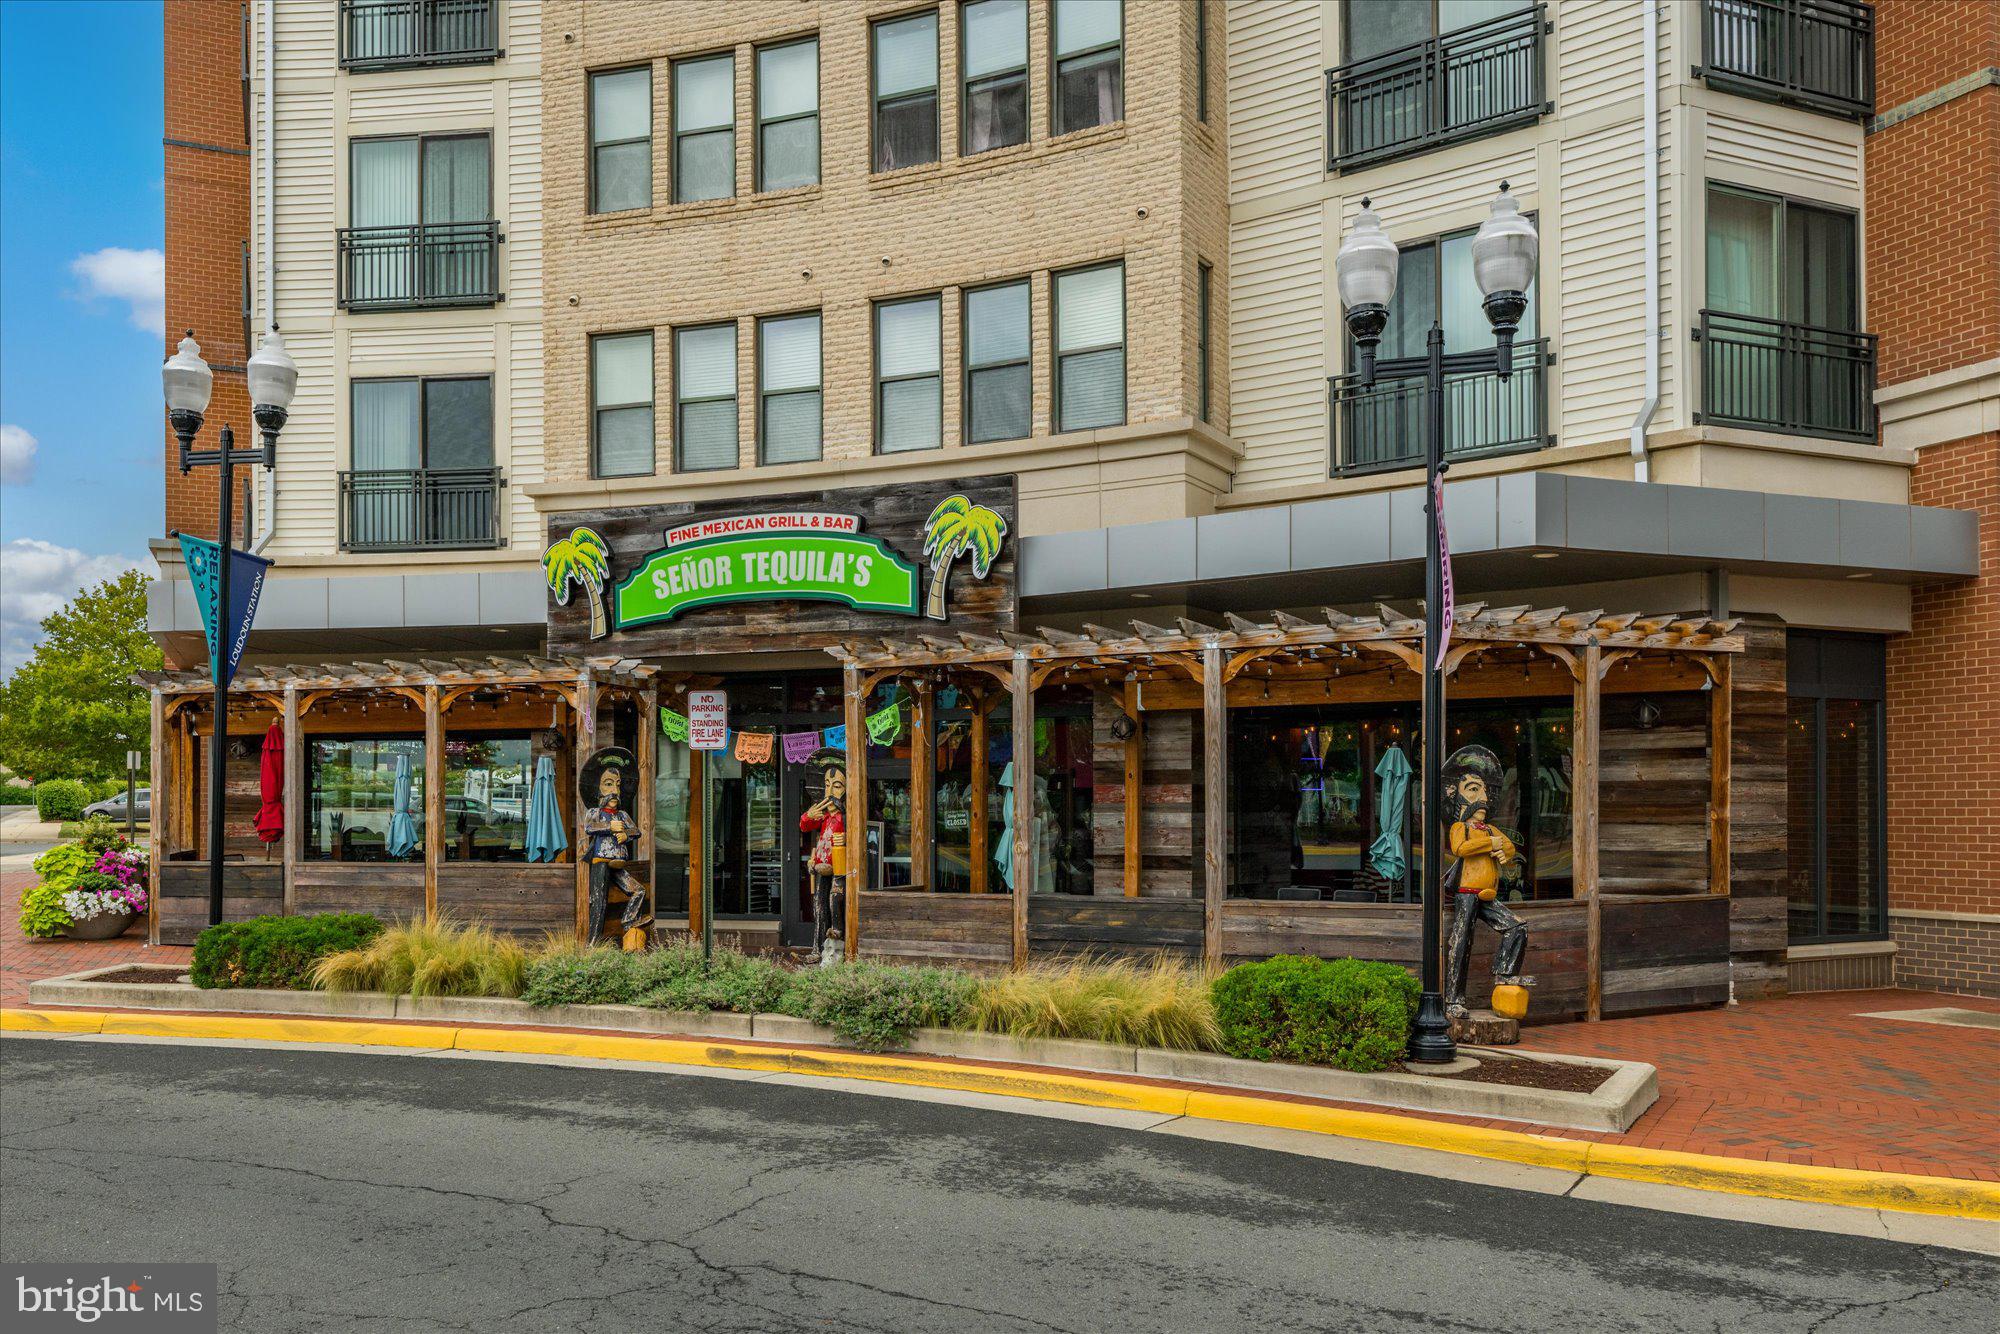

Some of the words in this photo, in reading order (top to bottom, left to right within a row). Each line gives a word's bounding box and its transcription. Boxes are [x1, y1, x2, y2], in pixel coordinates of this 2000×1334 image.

[669, 526, 700, 543] FINE
[703, 517, 765, 536] MEXICAN
[768, 515, 808, 528] GRILL
[810, 515, 820, 528] &
[823, 516, 854, 530] BAR
[651, 555, 733, 600] SEÑOR
[741, 550, 873, 587] TEQUILA'S
[209, 545, 220, 657] RELAXING
[229, 615, 251, 667] LOUDOUN
[247, 571, 263, 617] STATION
[691, 704, 724, 712] PARKING
[701, 695, 714, 703] NO
[691, 719, 724, 727] STANDING
[691, 728, 706, 738] FIRE
[707, 728, 724, 738] LANE
